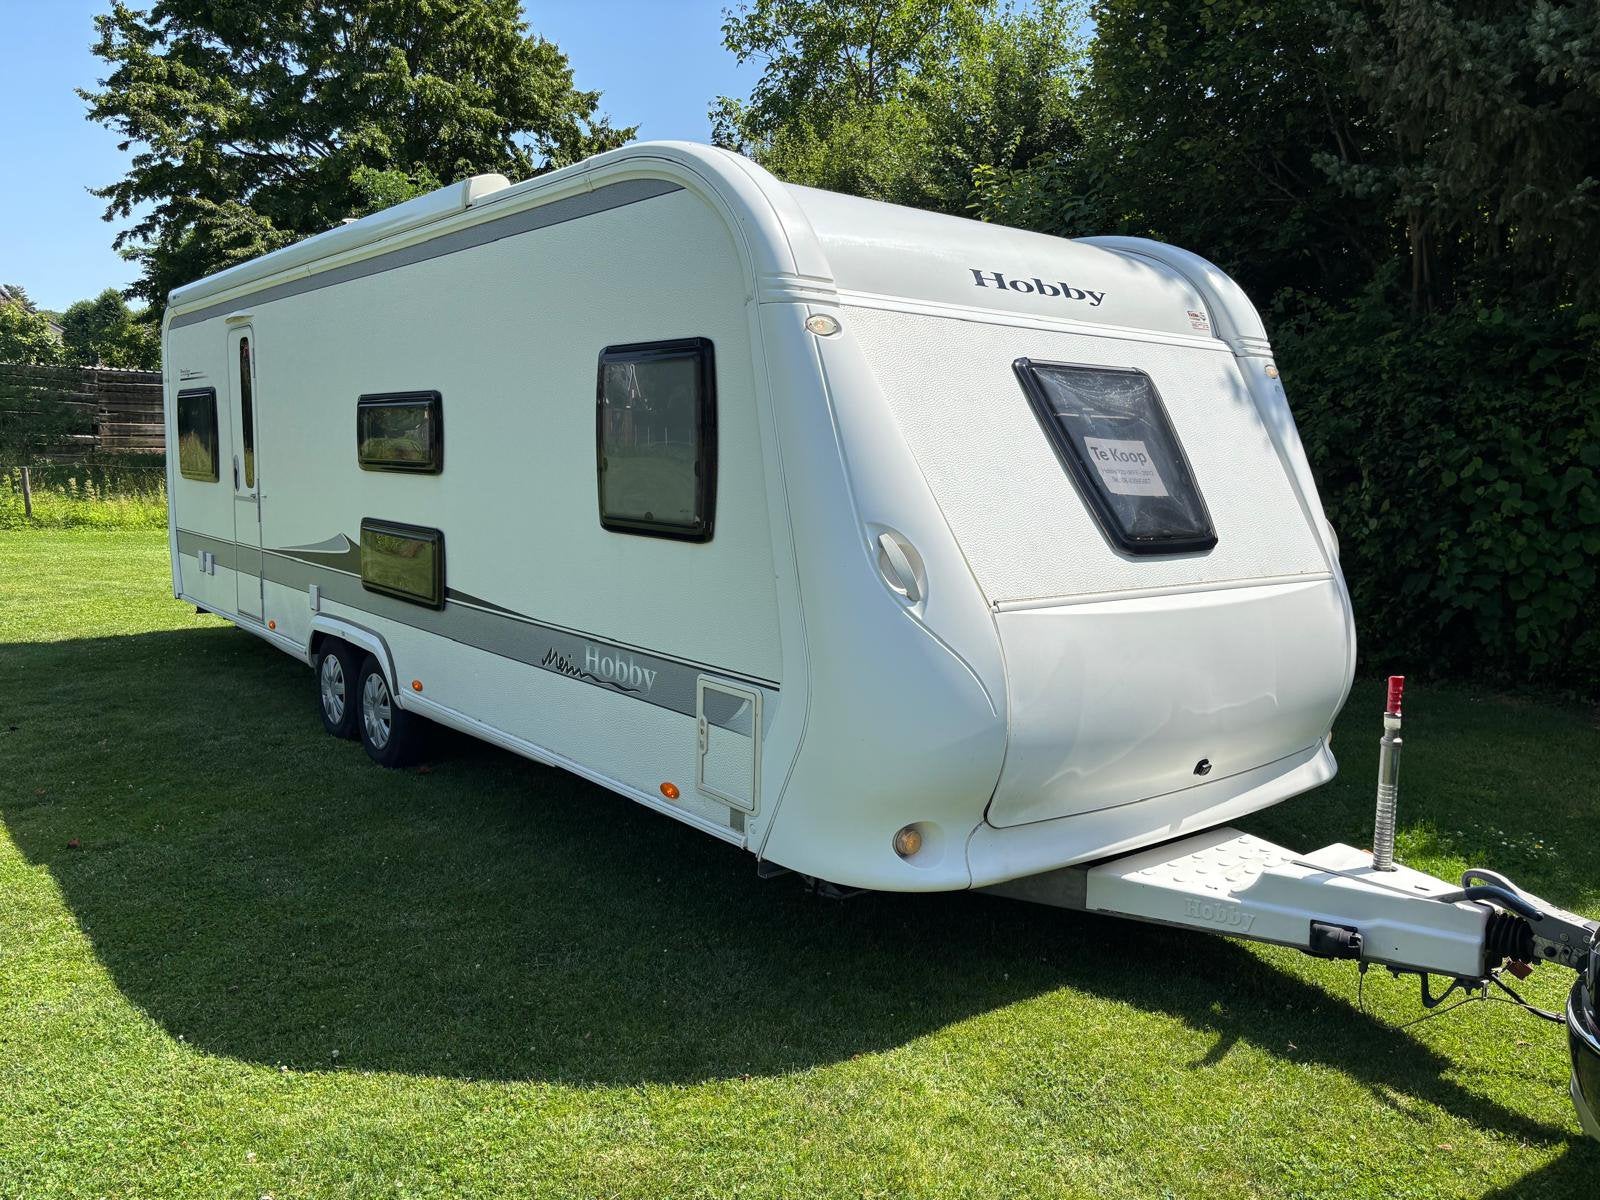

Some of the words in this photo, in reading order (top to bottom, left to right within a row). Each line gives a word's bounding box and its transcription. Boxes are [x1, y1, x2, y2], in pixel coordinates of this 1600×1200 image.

[969, 268, 1106, 306] Hobby
[1091, 446, 1109, 461] Te
[1109, 447, 1148, 466] Koop
[541, 647, 587, 678] Mein
[584, 644, 658, 695] Hobby
[1183, 897, 1256, 933] Hobby
